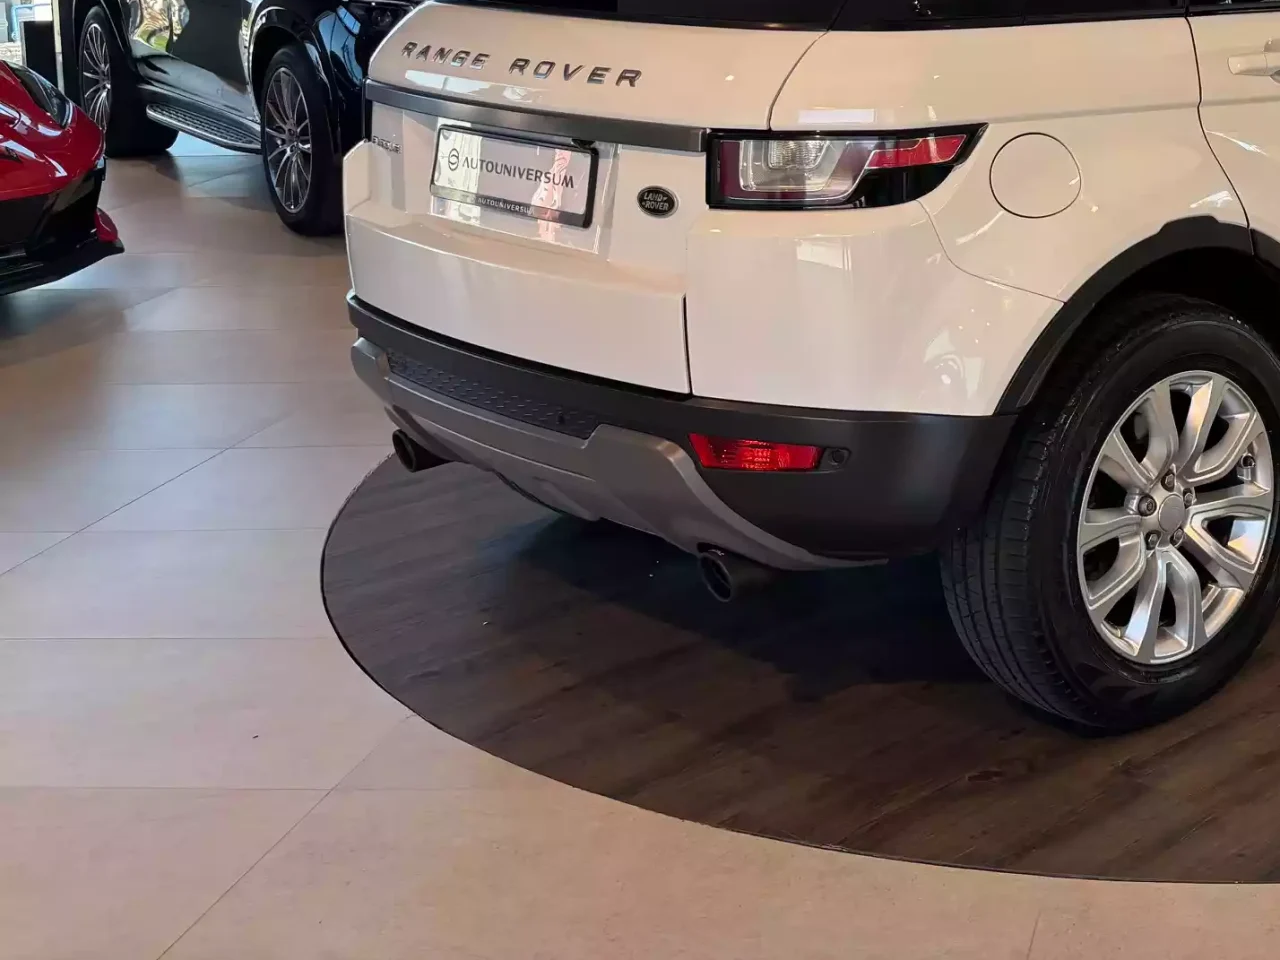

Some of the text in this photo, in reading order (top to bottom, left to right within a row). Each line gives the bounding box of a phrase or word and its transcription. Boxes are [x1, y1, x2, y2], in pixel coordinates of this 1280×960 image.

[401, 41, 642, 88] RANGE ROVER
[462, 158, 574, 188] AUTOUNIVERSUM
[643, 192, 664, 202] LAND
[645, 201, 670, 211] ROVER
